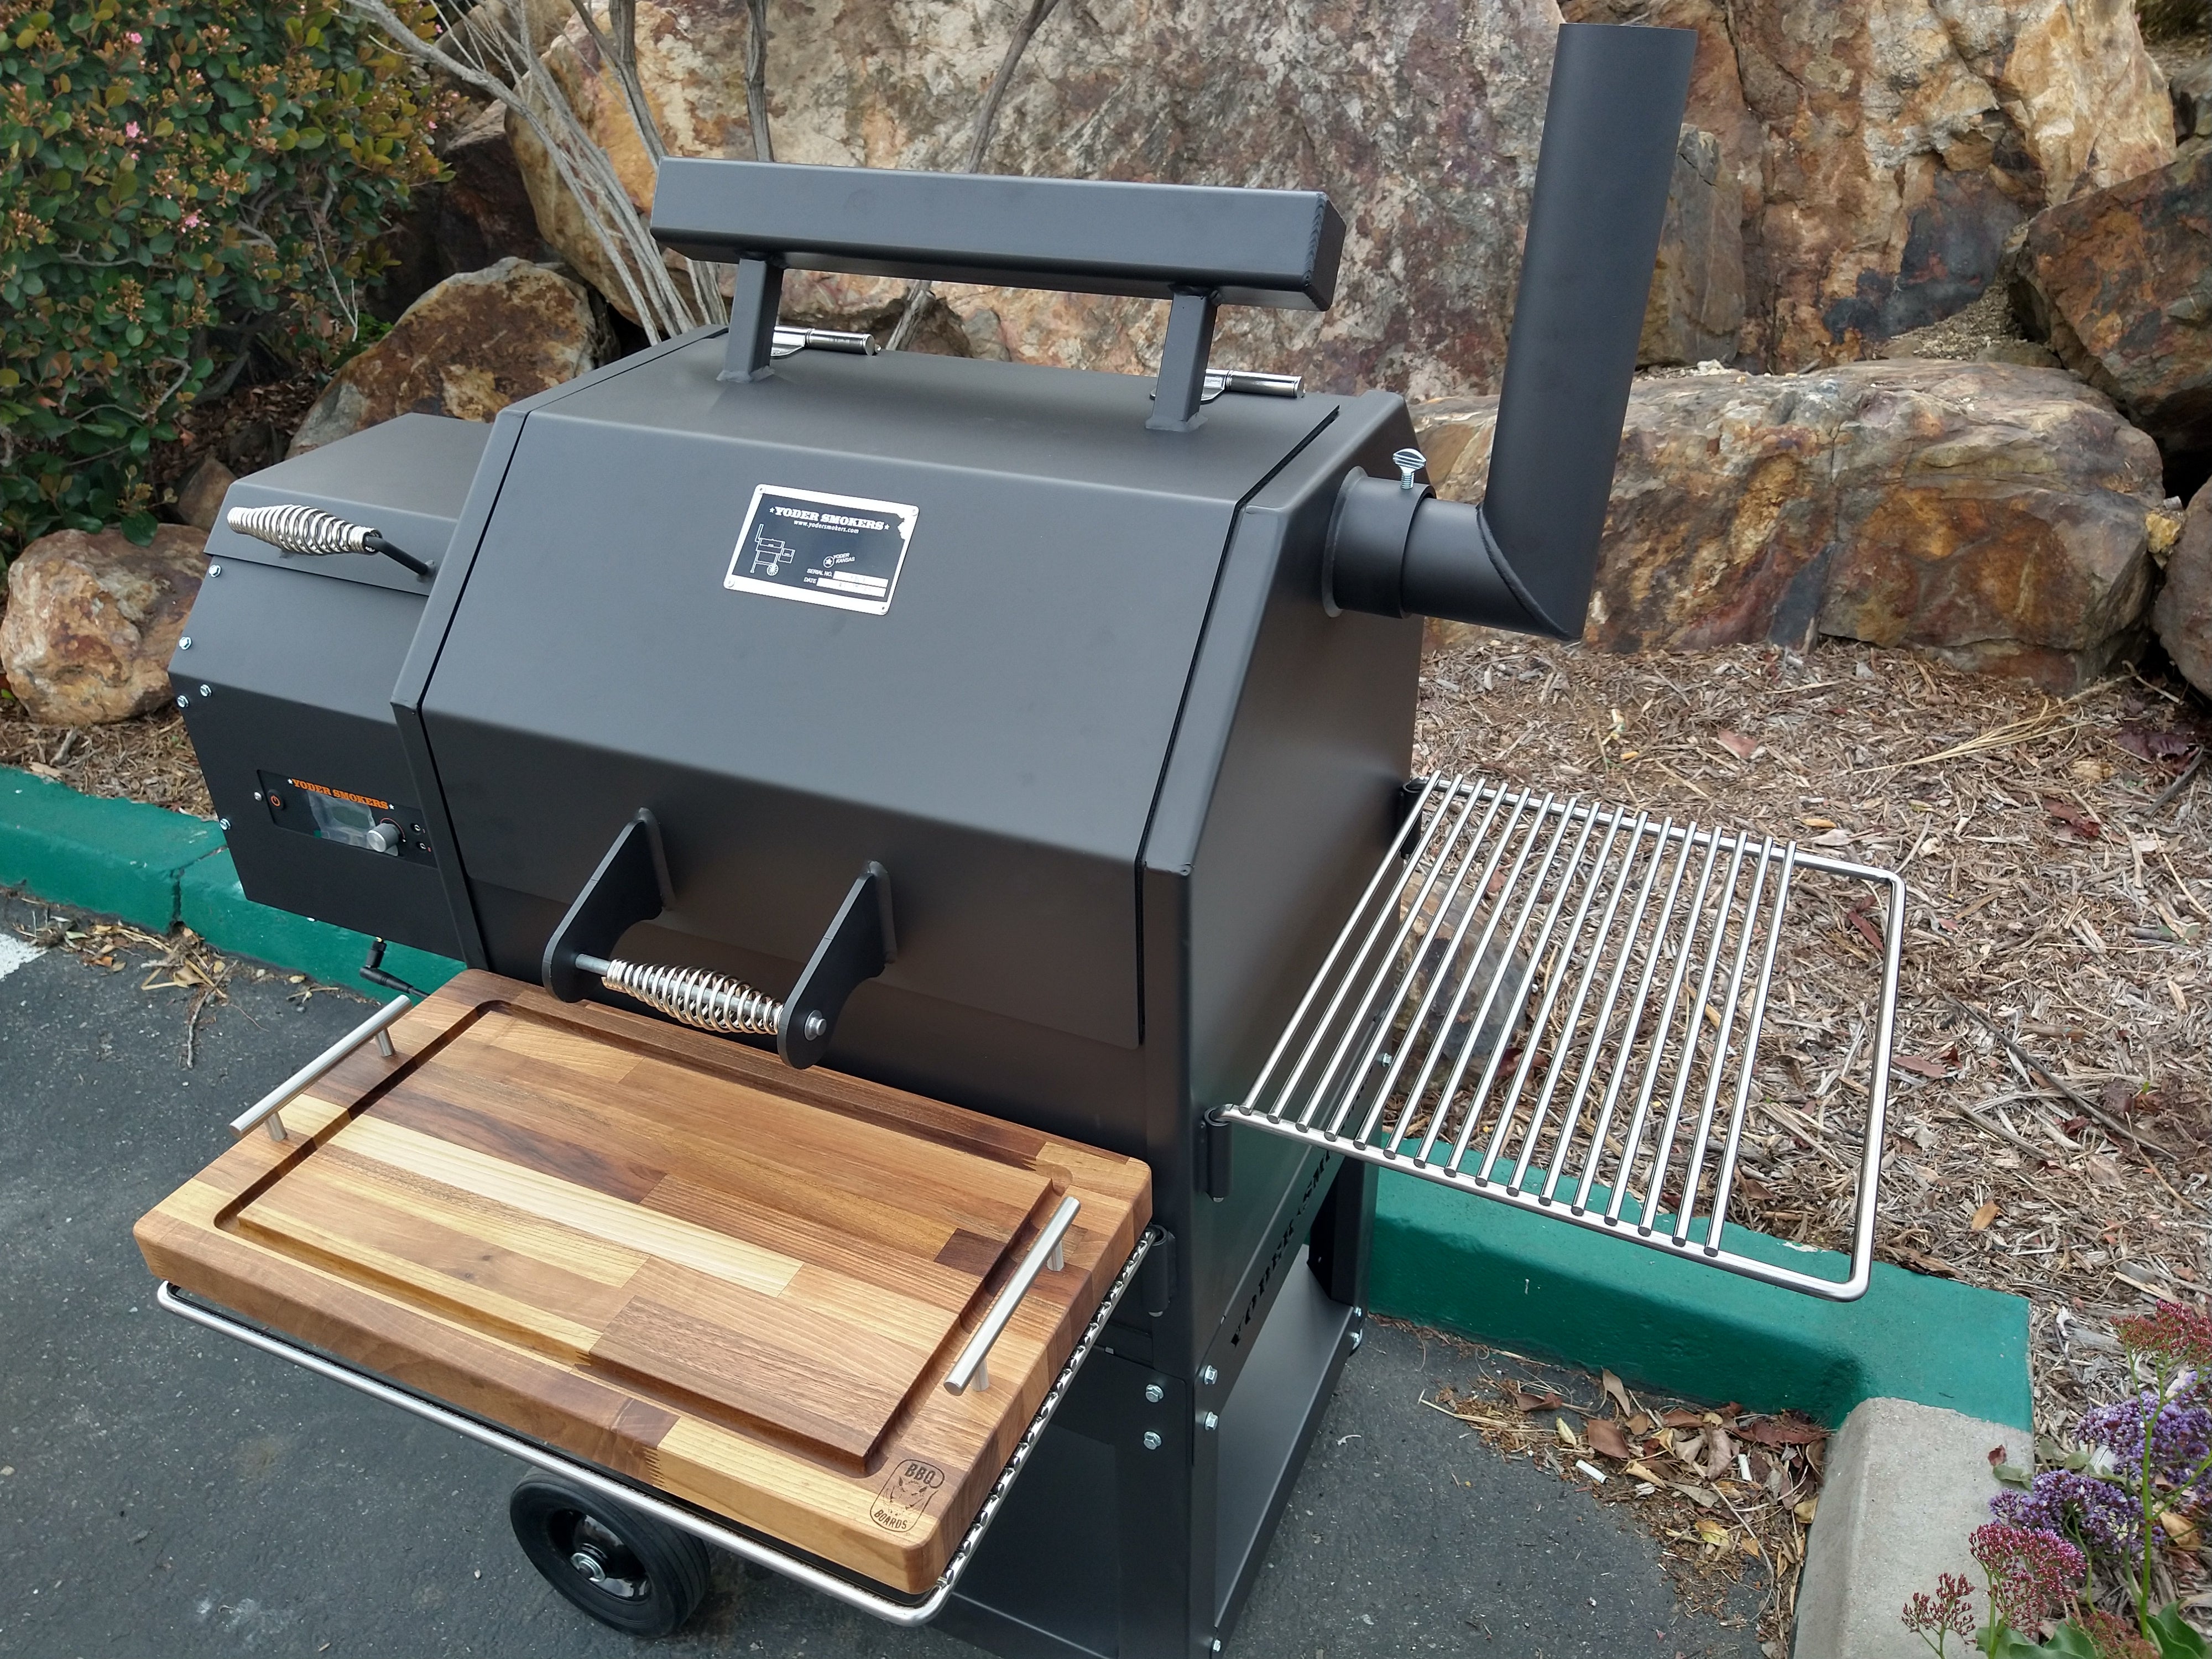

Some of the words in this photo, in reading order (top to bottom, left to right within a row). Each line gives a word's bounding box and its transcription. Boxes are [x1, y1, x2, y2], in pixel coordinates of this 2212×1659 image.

[774, 506, 820, 521] YODER
[820, 513, 885, 530] SMOKERS
[794, 520, 859, 534] www.yodersmokers.com
[291, 778, 331, 796] YODER
[332, 789, 389, 810] SMOKERS
[904, 1463, 936, 1485] BBQ
[874, 1509, 908, 1530] BOARDS
